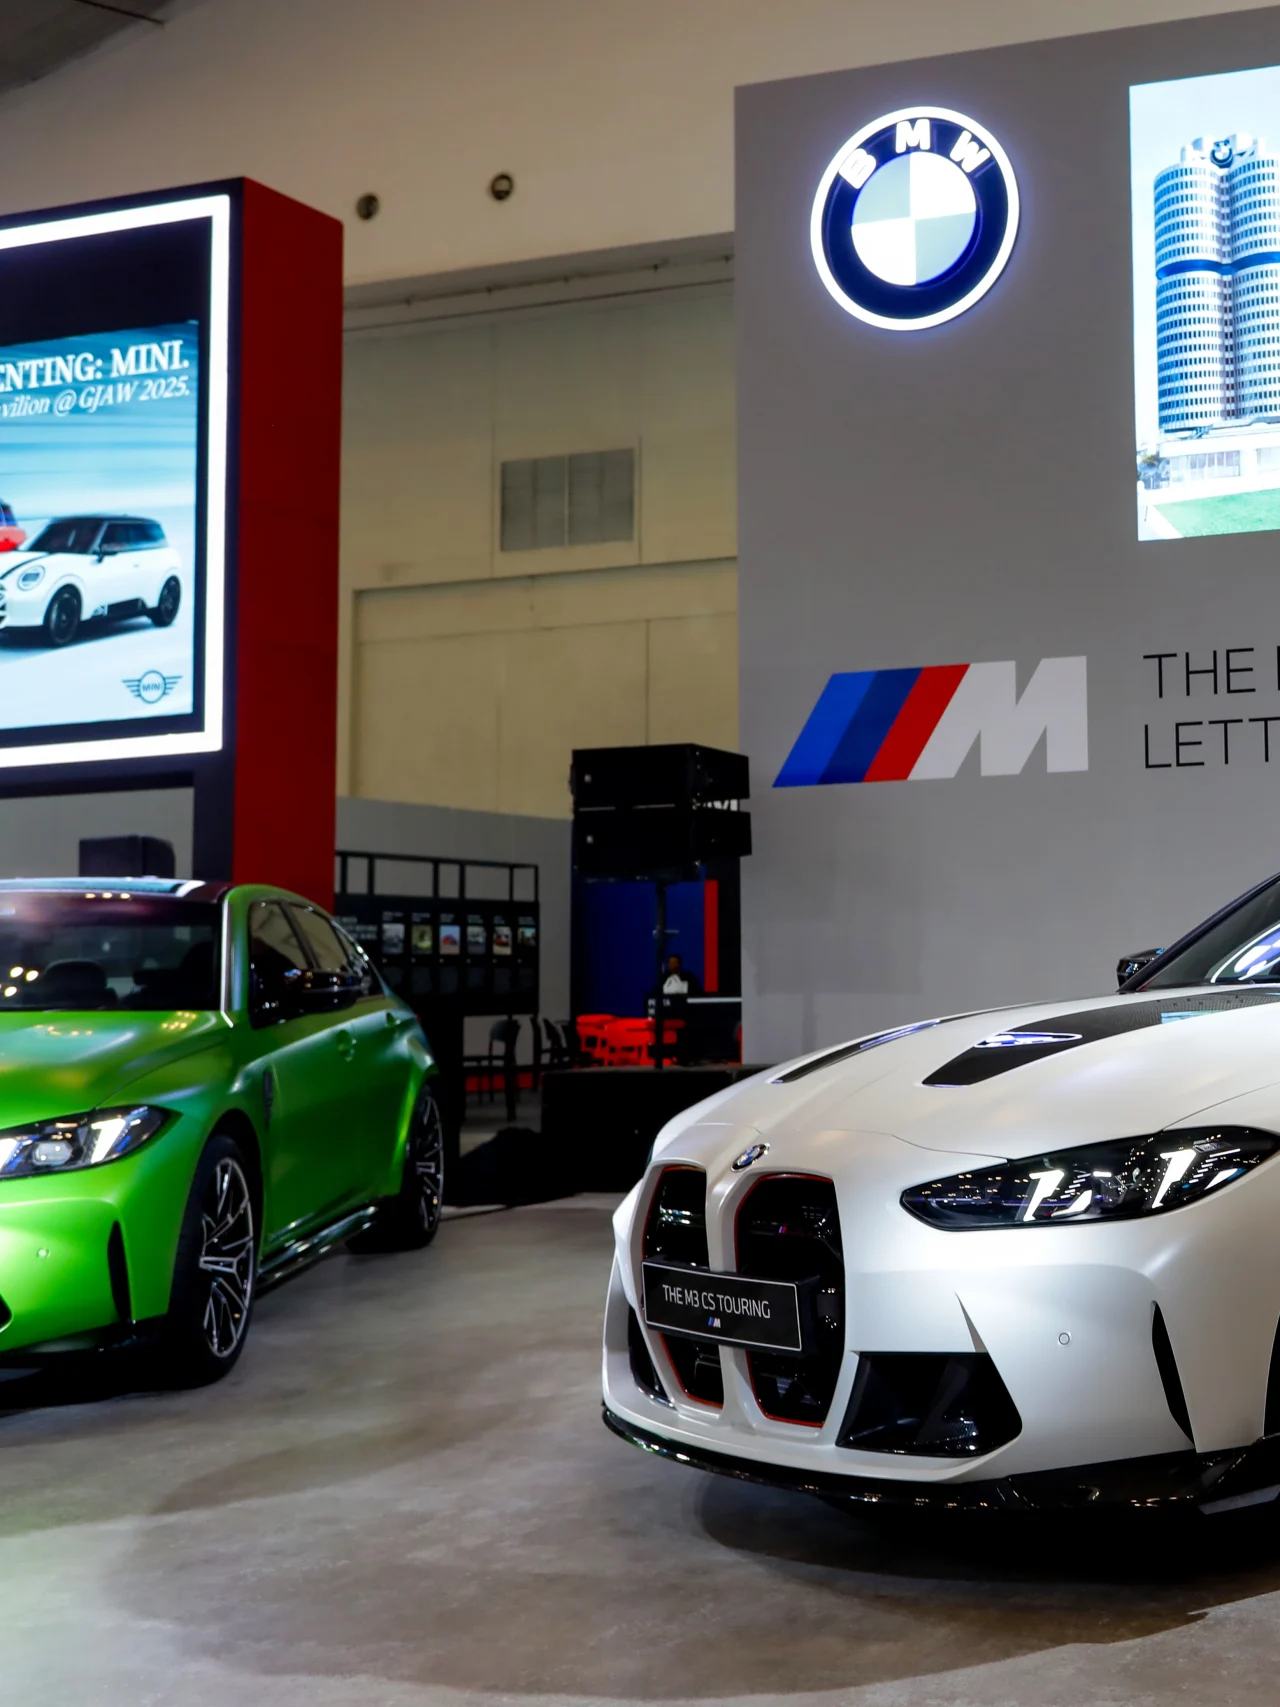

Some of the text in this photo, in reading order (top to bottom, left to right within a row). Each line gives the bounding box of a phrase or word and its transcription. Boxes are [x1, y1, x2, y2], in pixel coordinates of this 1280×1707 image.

[838, 118, 991, 190] BMW
[110, 339, 190, 378] MINI.
[53, 389, 77, 417] @
[79, 381, 138, 413] GJAW
[138, 376, 190, 402] 2025.
[141, 682, 163, 693] MINI
[1143, 647, 1256, 699] THE
[906, 655, 1089, 781] M
[662, 1284, 771, 1319] THE M3 CS TOURING
